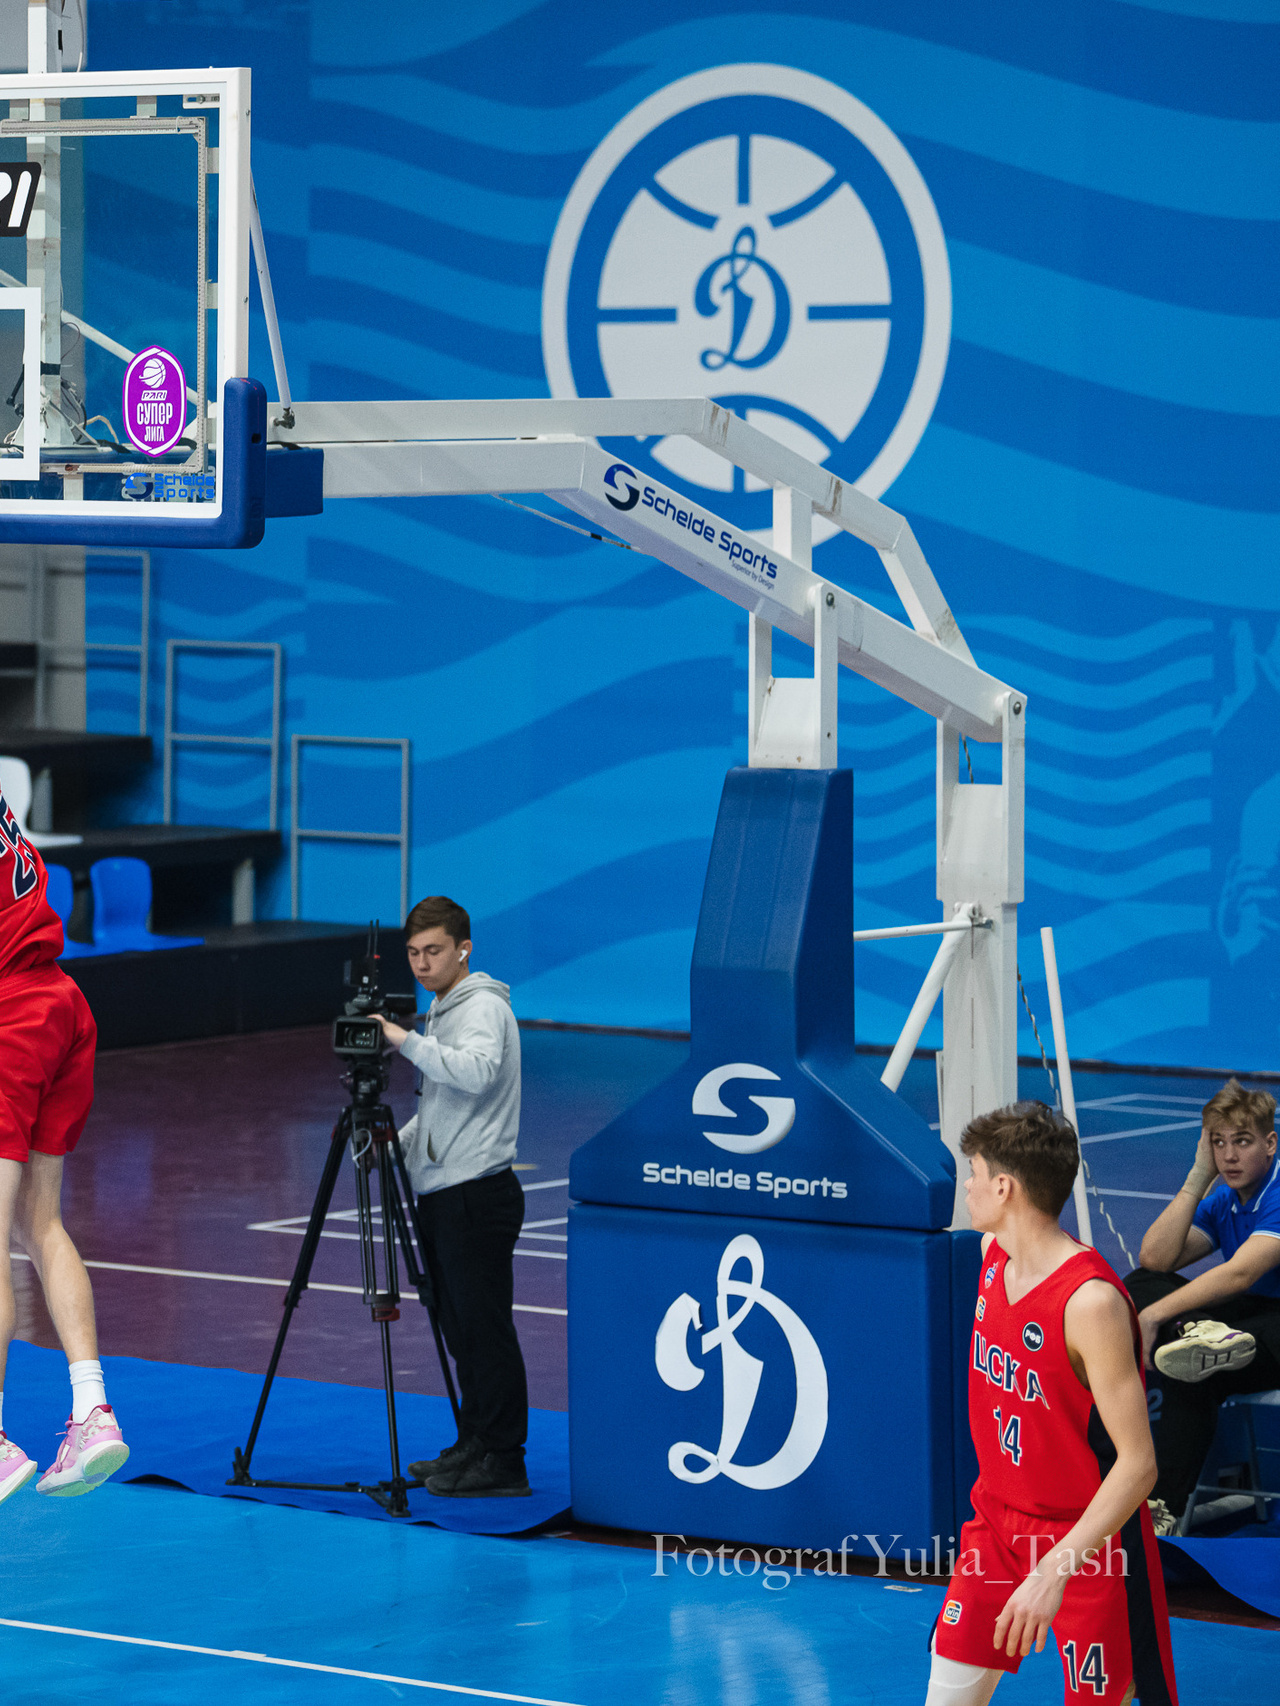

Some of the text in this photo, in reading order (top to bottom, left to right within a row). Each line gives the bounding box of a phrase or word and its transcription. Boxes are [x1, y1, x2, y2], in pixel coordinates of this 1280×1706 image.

[144, 426, 165, 442] ЛИГА
[154, 473, 215, 486] Schelde
[154, 486, 215, 501] Sports
[641, 486, 778, 579] Schelde Sports
[643, 1162, 848, 1199] Schelde Sports
[993, 1405, 1022, 1467] 14
[1062, 1640, 1109, 1697] 14
